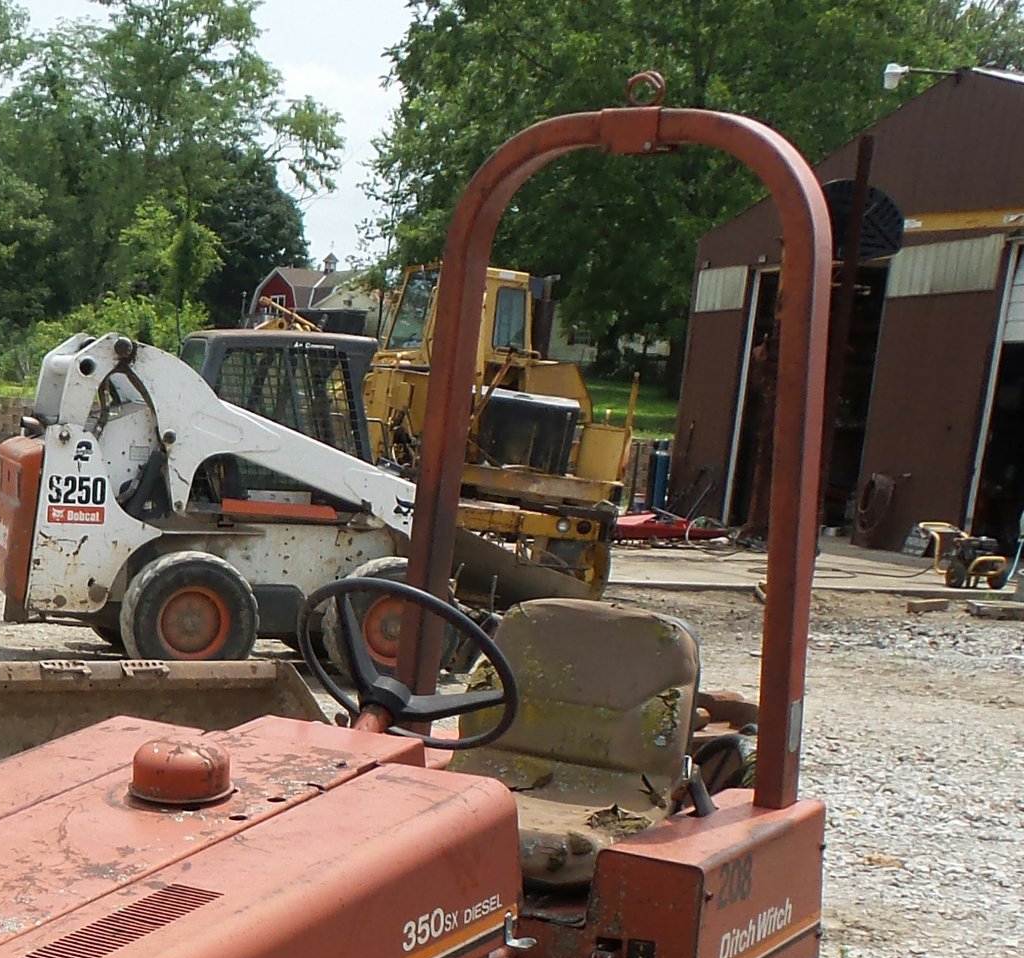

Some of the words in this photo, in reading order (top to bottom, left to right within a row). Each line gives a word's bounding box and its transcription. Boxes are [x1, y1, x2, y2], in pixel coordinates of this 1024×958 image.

[47, 474, 107, 505] S250
[67, 510, 100, 523] Bobcat
[464, 893, 503, 924] DIESEL
